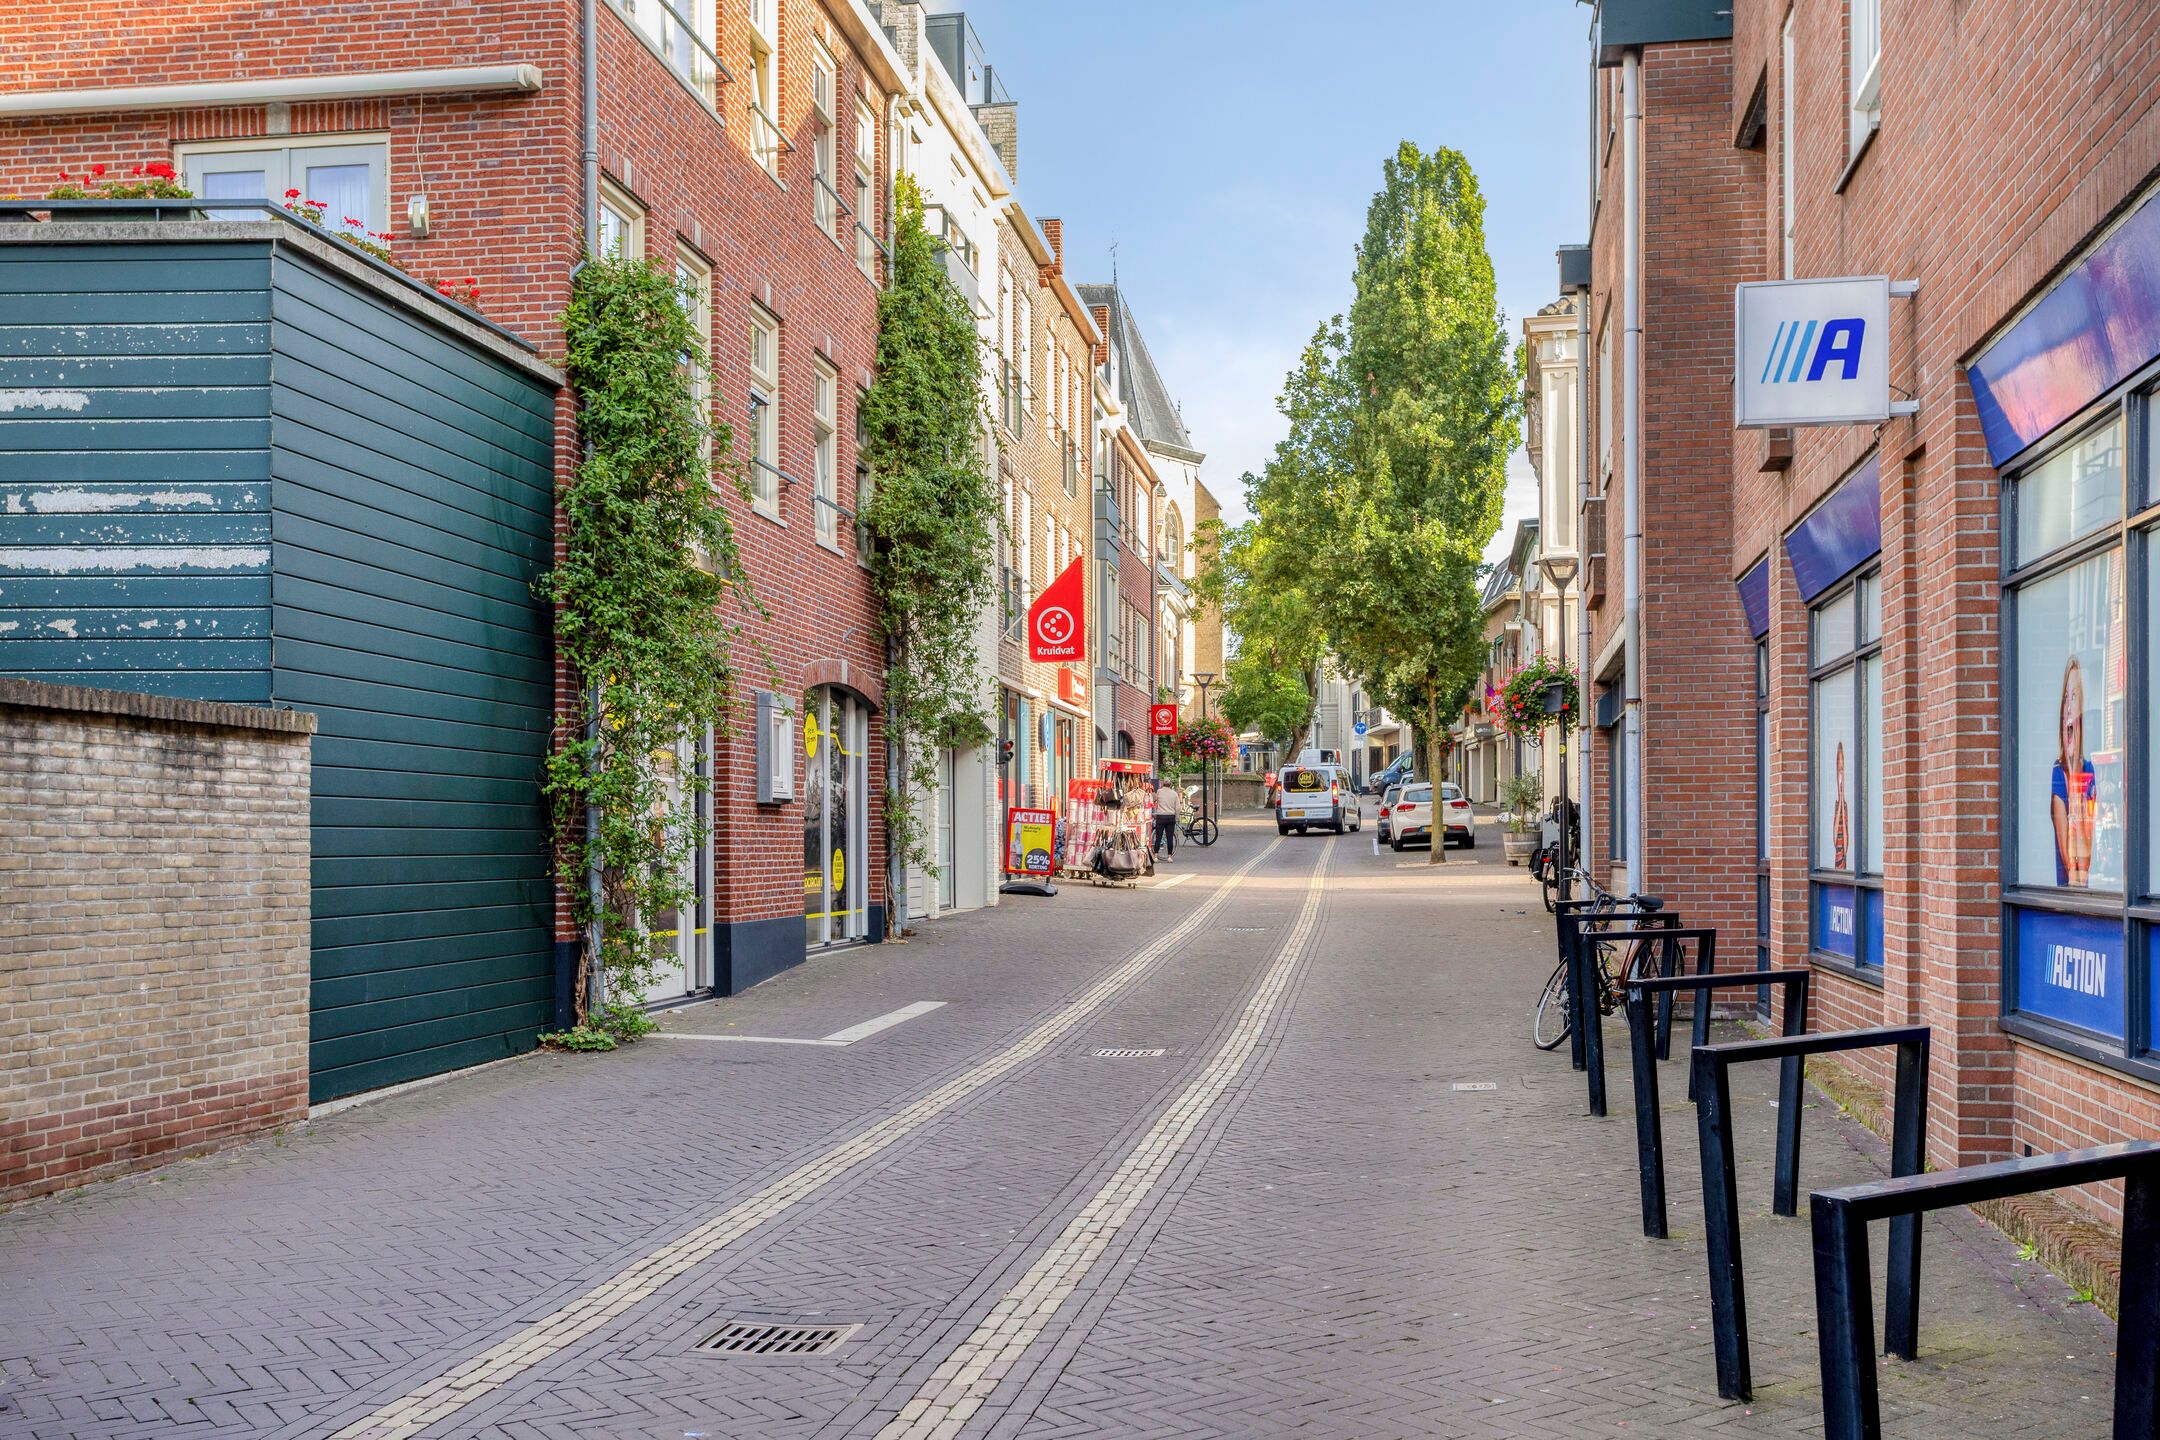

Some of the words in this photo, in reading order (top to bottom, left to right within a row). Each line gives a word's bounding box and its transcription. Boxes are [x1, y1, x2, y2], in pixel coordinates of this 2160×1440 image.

[1806, 318, 1866, 382] A
[1037, 646, 1075, 656] Kruidvat
[1013, 811, 1051, 824] ACTIE!
[1026, 854, 1051, 866] 25%
[1831, 905, 1853, 936] ACTION
[2052, 945, 2107, 998] ACTION
